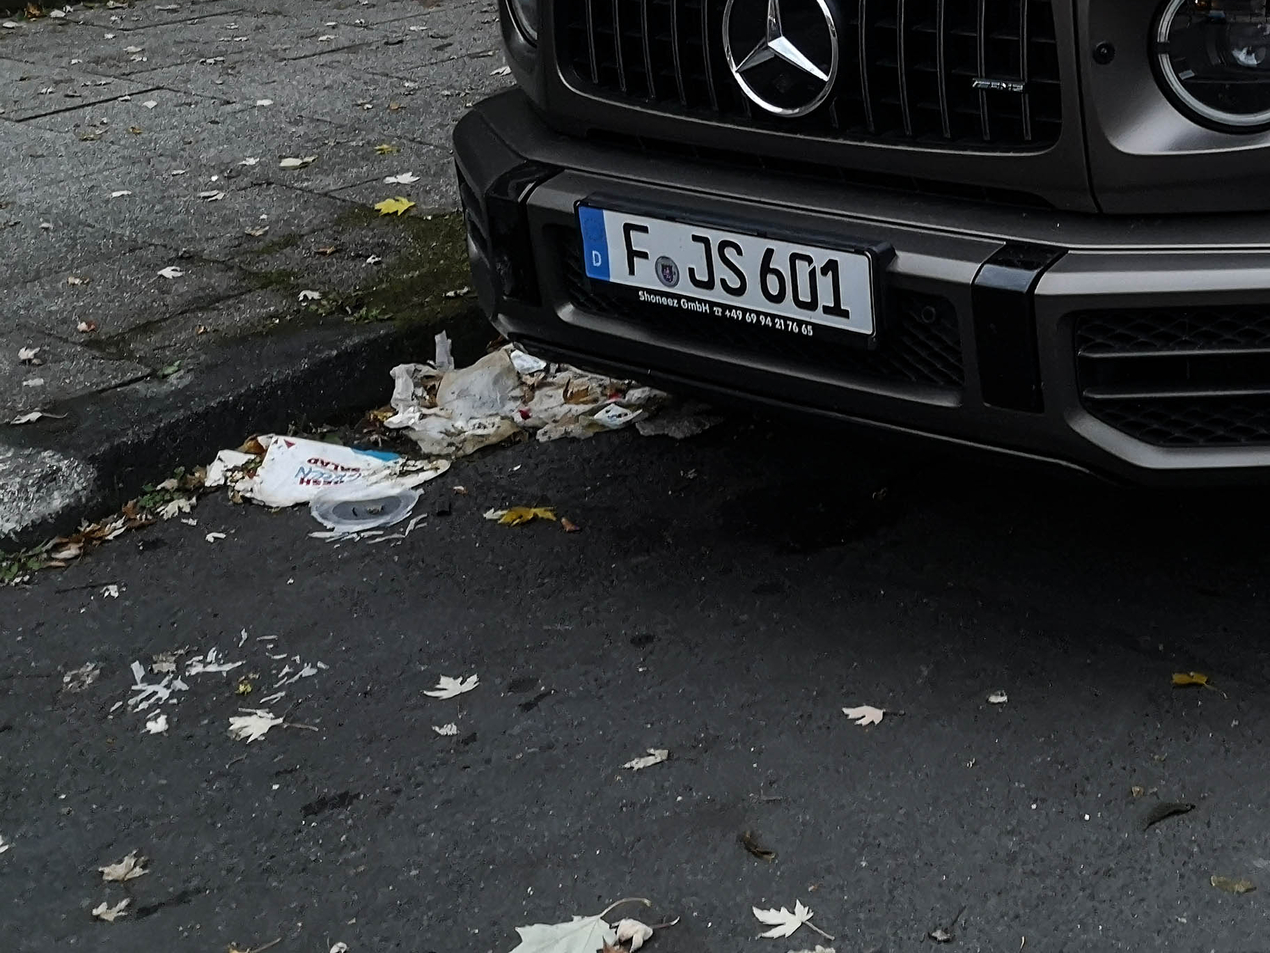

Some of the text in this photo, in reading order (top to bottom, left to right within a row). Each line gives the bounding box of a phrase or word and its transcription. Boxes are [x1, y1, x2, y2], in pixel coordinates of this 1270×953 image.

[591, 250, 602, 267] D
[622, 222, 851, 320] F JS 601
[638, 290, 813, 336] Shoneez GmbH +49 69 94 21 76 65
